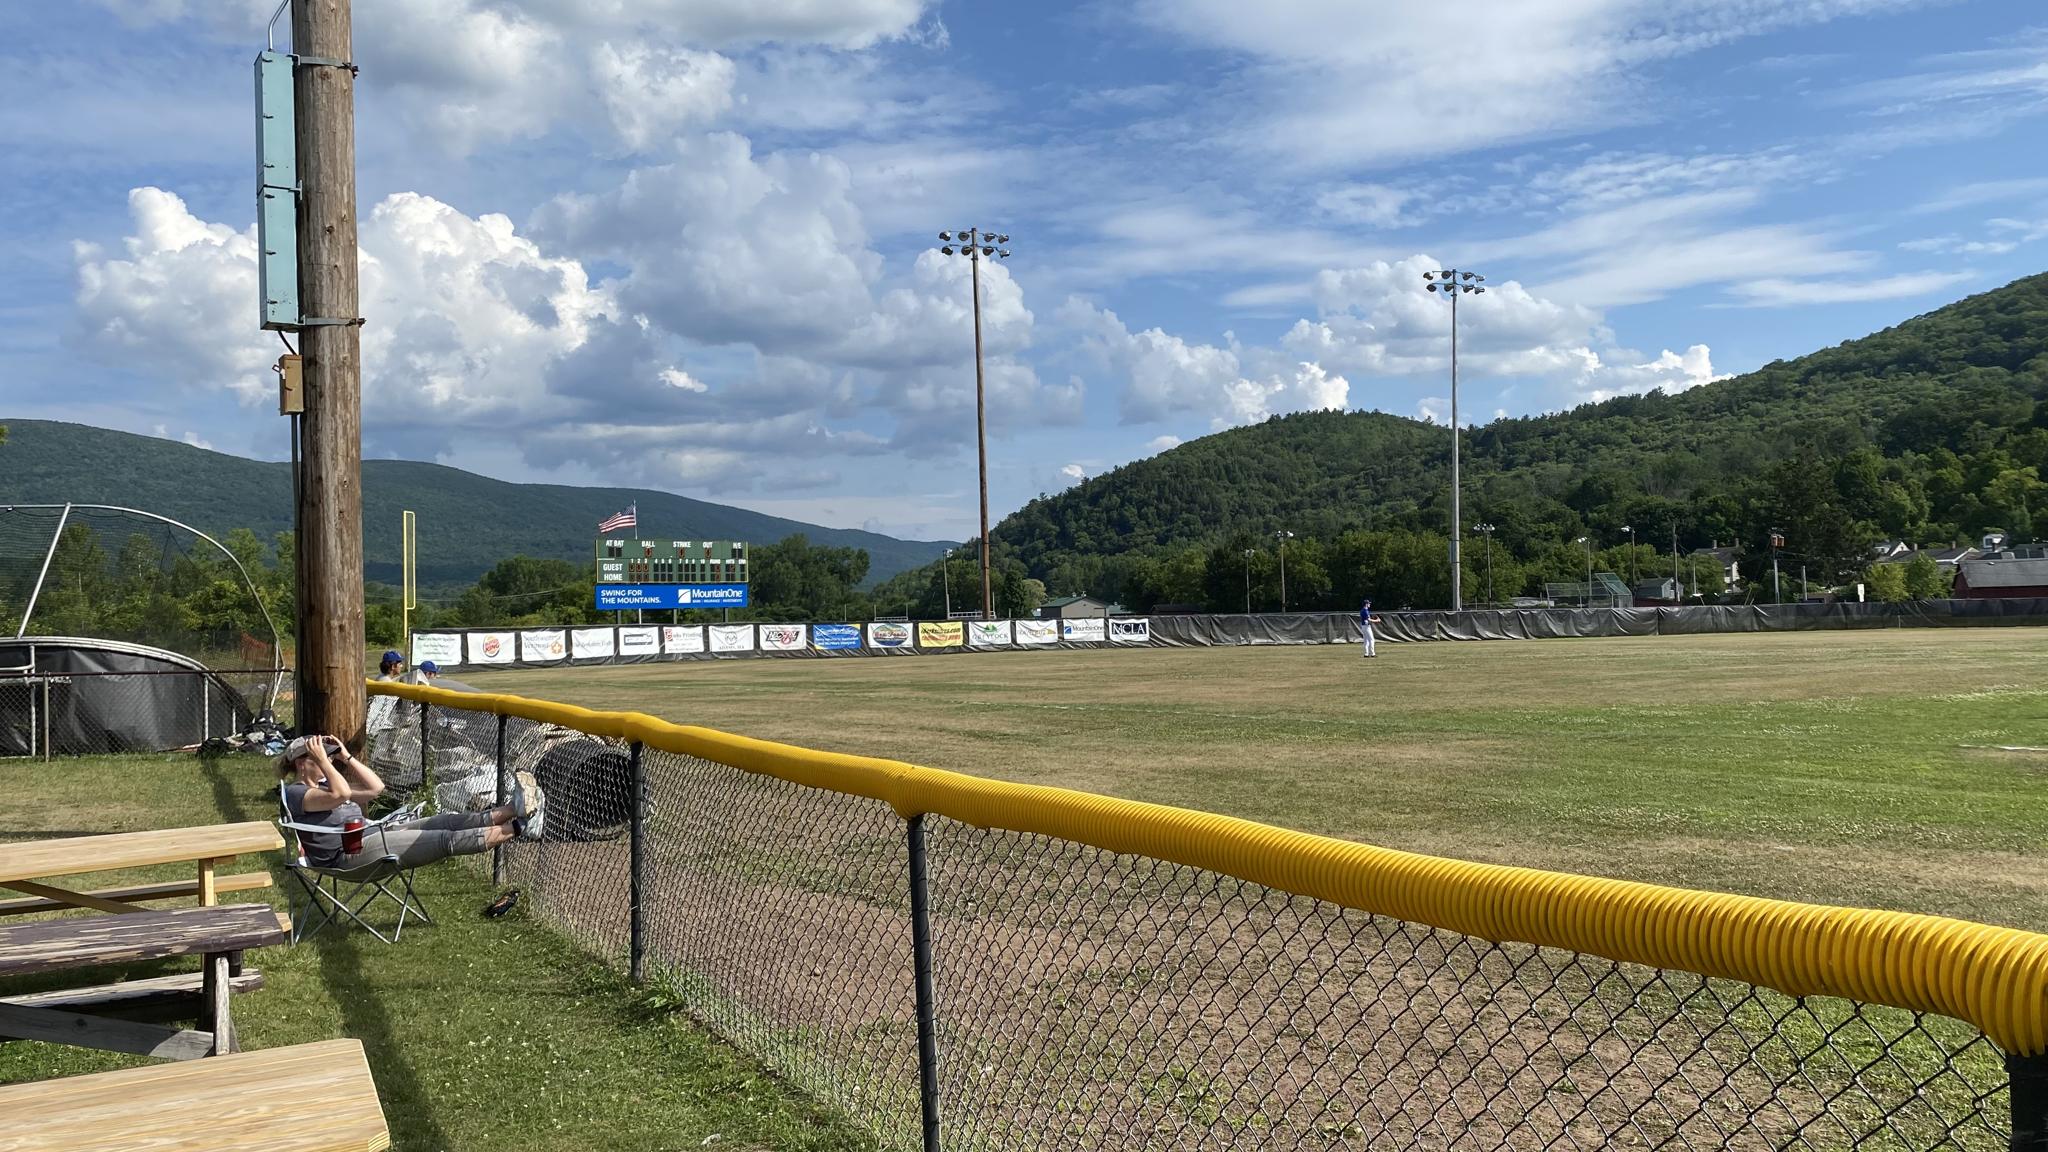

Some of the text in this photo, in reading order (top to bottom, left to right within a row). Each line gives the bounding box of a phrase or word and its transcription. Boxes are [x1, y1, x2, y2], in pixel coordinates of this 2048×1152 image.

[603, 563, 623, 571] GUEST
[601, 589, 643, 597] SWING FOR
[692, 588, 743, 598] MountainOne
[617, 596, 662, 604] MOUNTAINS.
[1112, 623, 1146, 636] NCLA
[485, 643, 500, 652] KING
